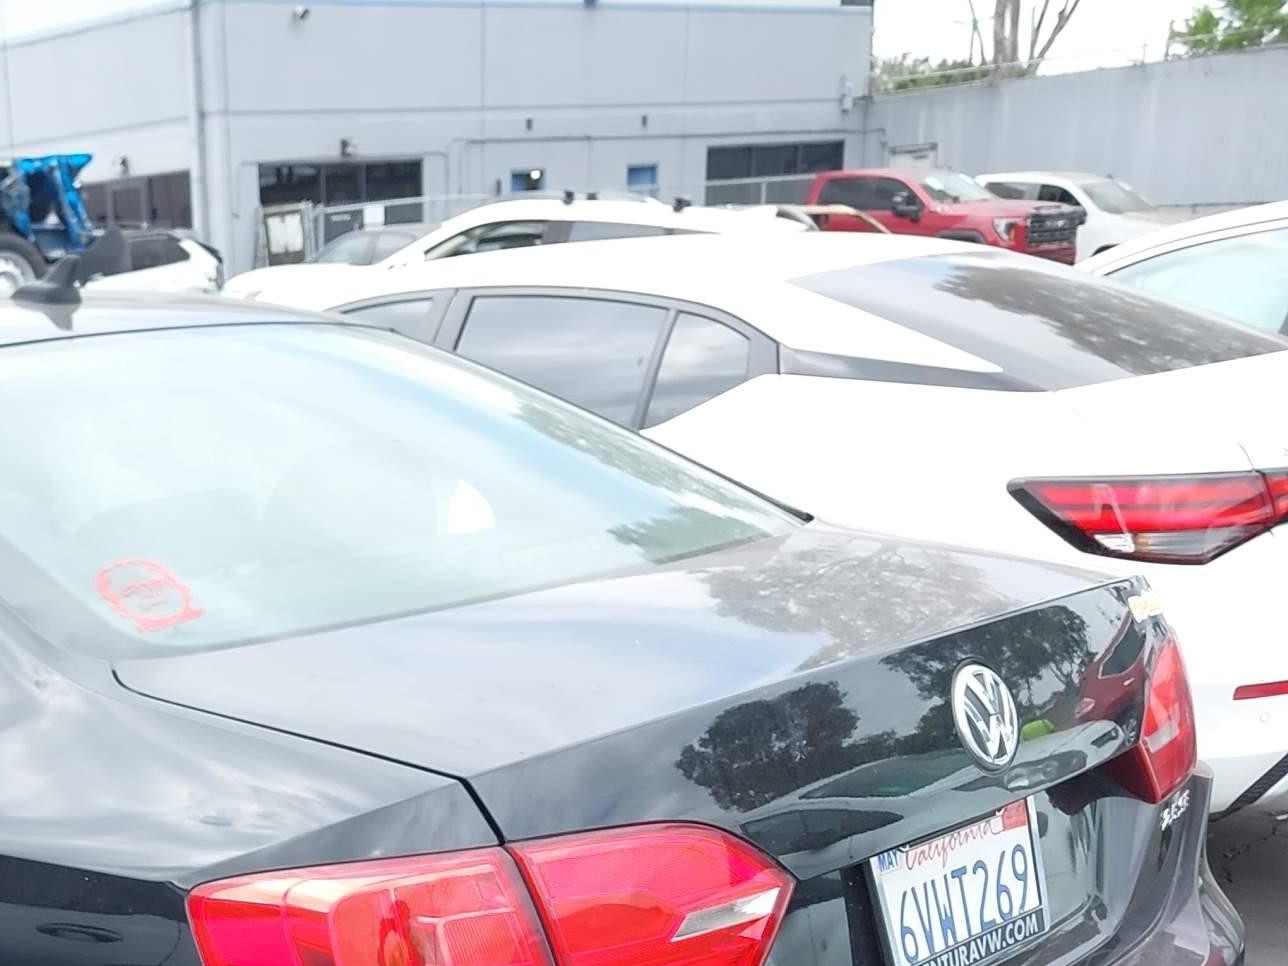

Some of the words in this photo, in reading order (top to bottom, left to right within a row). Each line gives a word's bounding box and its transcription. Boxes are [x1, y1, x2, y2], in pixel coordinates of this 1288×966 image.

[877, 848, 899, 873] MAY
[905, 821, 1003, 871] California
[900, 844, 1028, 966] 6VWT269
